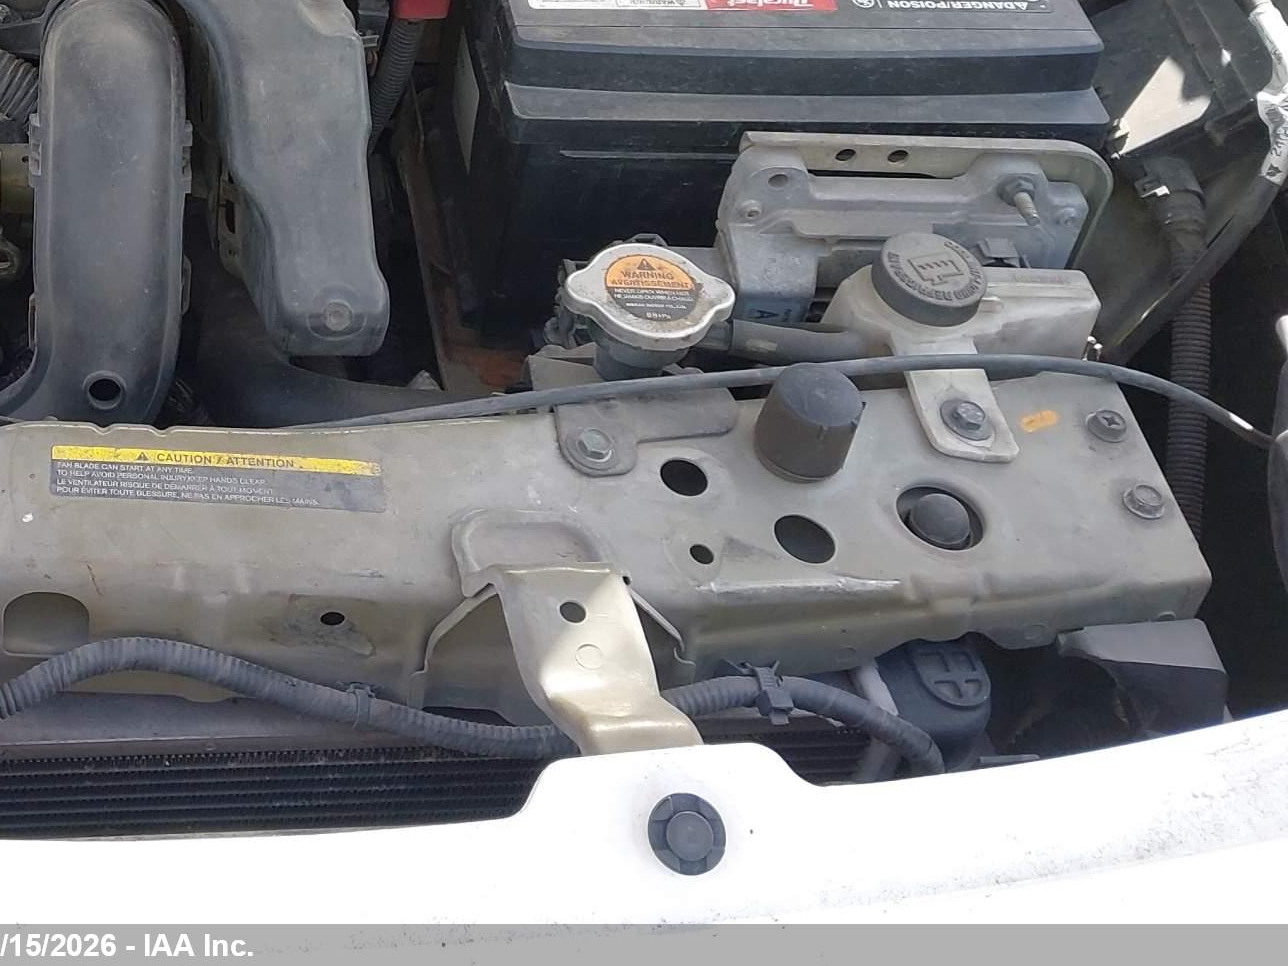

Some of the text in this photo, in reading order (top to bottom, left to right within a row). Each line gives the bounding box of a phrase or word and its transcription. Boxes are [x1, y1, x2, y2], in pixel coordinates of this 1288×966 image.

[887, 0, 1016, 9] DANGER/POISON
[621, 271, 674, 279] WARNING
[157, 454, 212, 464] CAUTION
[226, 457, 294, 468] ATTENTION
[120, 481, 149, 489] RISQUE
[81, 486, 108, 494] ÉVITER
[224, 495, 275, 503] APPROCHER
